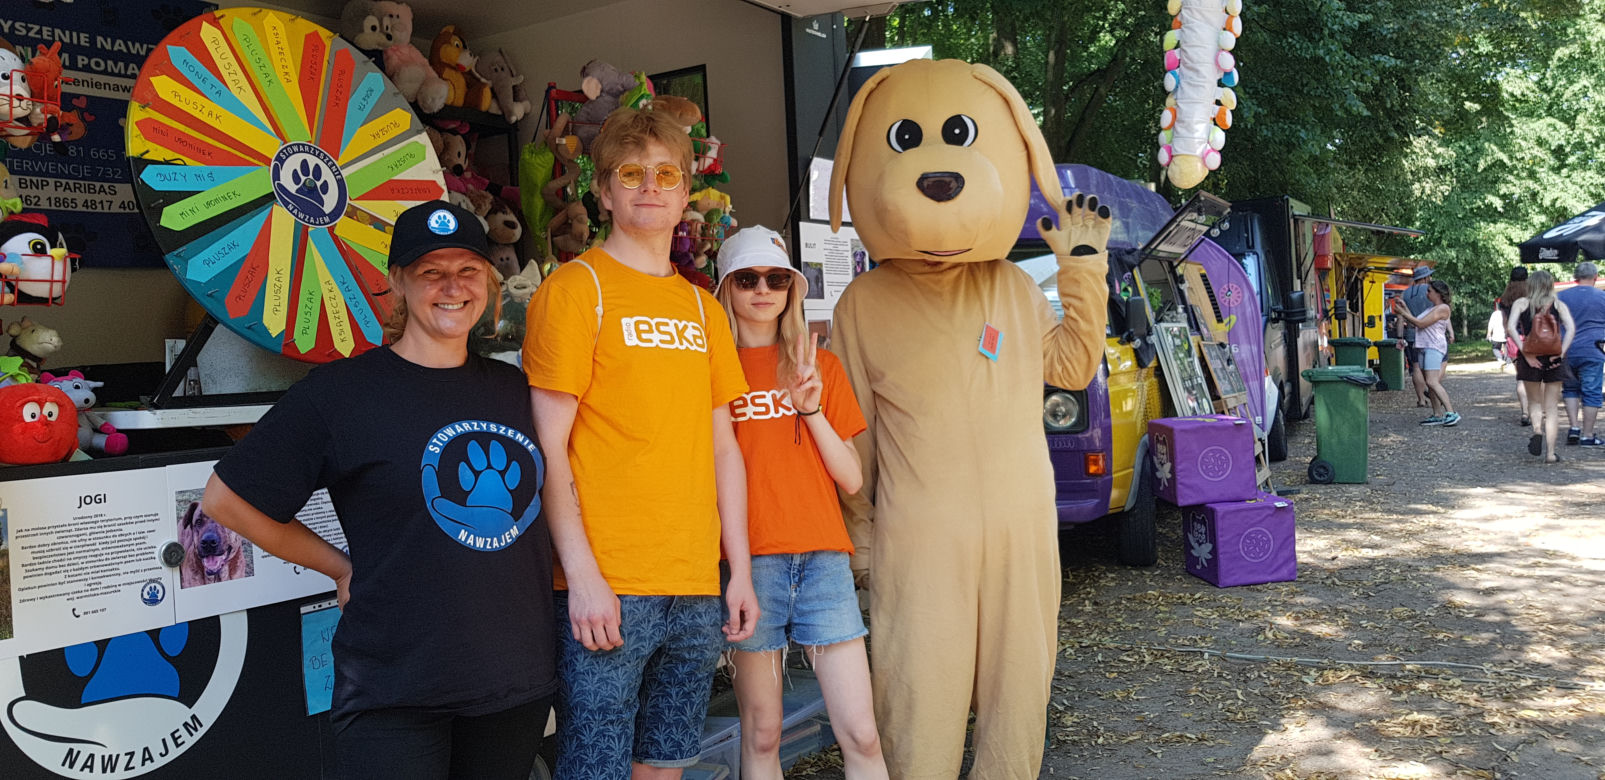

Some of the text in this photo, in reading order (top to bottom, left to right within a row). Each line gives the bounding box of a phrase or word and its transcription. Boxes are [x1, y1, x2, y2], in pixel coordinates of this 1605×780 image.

[210, 36, 247, 95] PLUSZAK
[242, 33, 275, 87] PLUSZAK
[182, 59, 223, 97] MONETA
[170, 90, 222, 124] PLUSZAK
[280, 145, 342, 181] STOWARZYSZENIE
[19, 178, 118, 196] BNP PARIBAS
[46, 196, 78, 209] 1865
[82, 199, 113, 212] 4817
[287, 203, 331, 225] NAWZAJEM
[202, 240, 239, 268] PLUSZAK
[234, 264, 259, 304] PLUSZAK
[272, 267, 284, 316] PLUSZAK
[339, 274, 372, 328] PLUSZAK
[302, 289, 315, 337] PLUSZAK
[633, 319, 707, 352] eska
[729, 391, 792, 419] esk
[428, 421, 536, 454] STOWARZYSZENIE
[77, 493, 107, 509] JOGI
[458, 525, 519, 549] NAWZAJEM
[60, 713, 204, 775] NAWZAJEM
